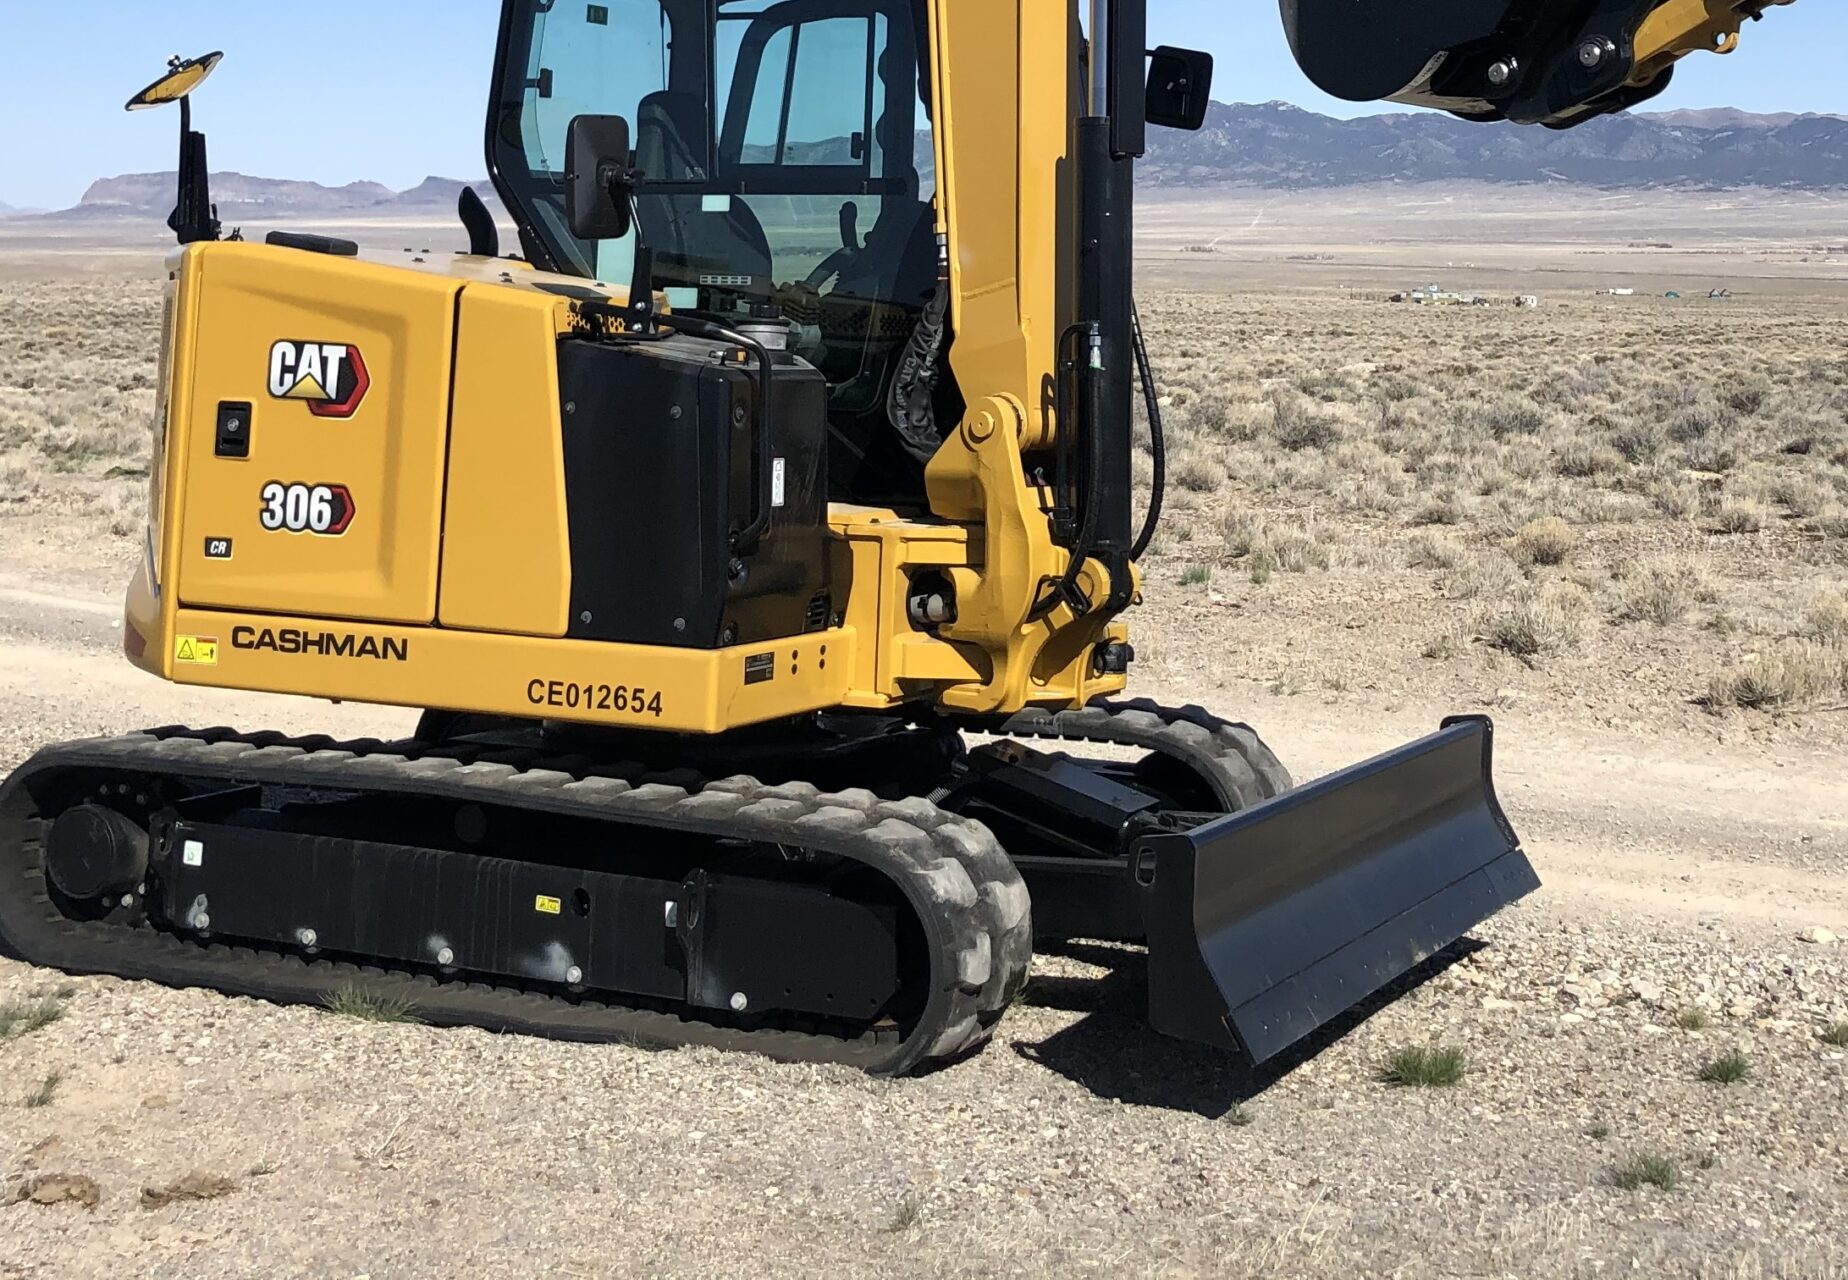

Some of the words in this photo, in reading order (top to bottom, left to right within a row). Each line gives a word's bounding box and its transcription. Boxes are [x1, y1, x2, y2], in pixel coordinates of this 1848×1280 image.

[270, 341, 347, 400] CAT
[900, 357, 917, 382] CAT
[262, 483, 332, 531] 306
[209, 540, 227, 555] CR
[231, 626, 408, 661] CASHMAN
[527, 678, 663, 718] CE012654
